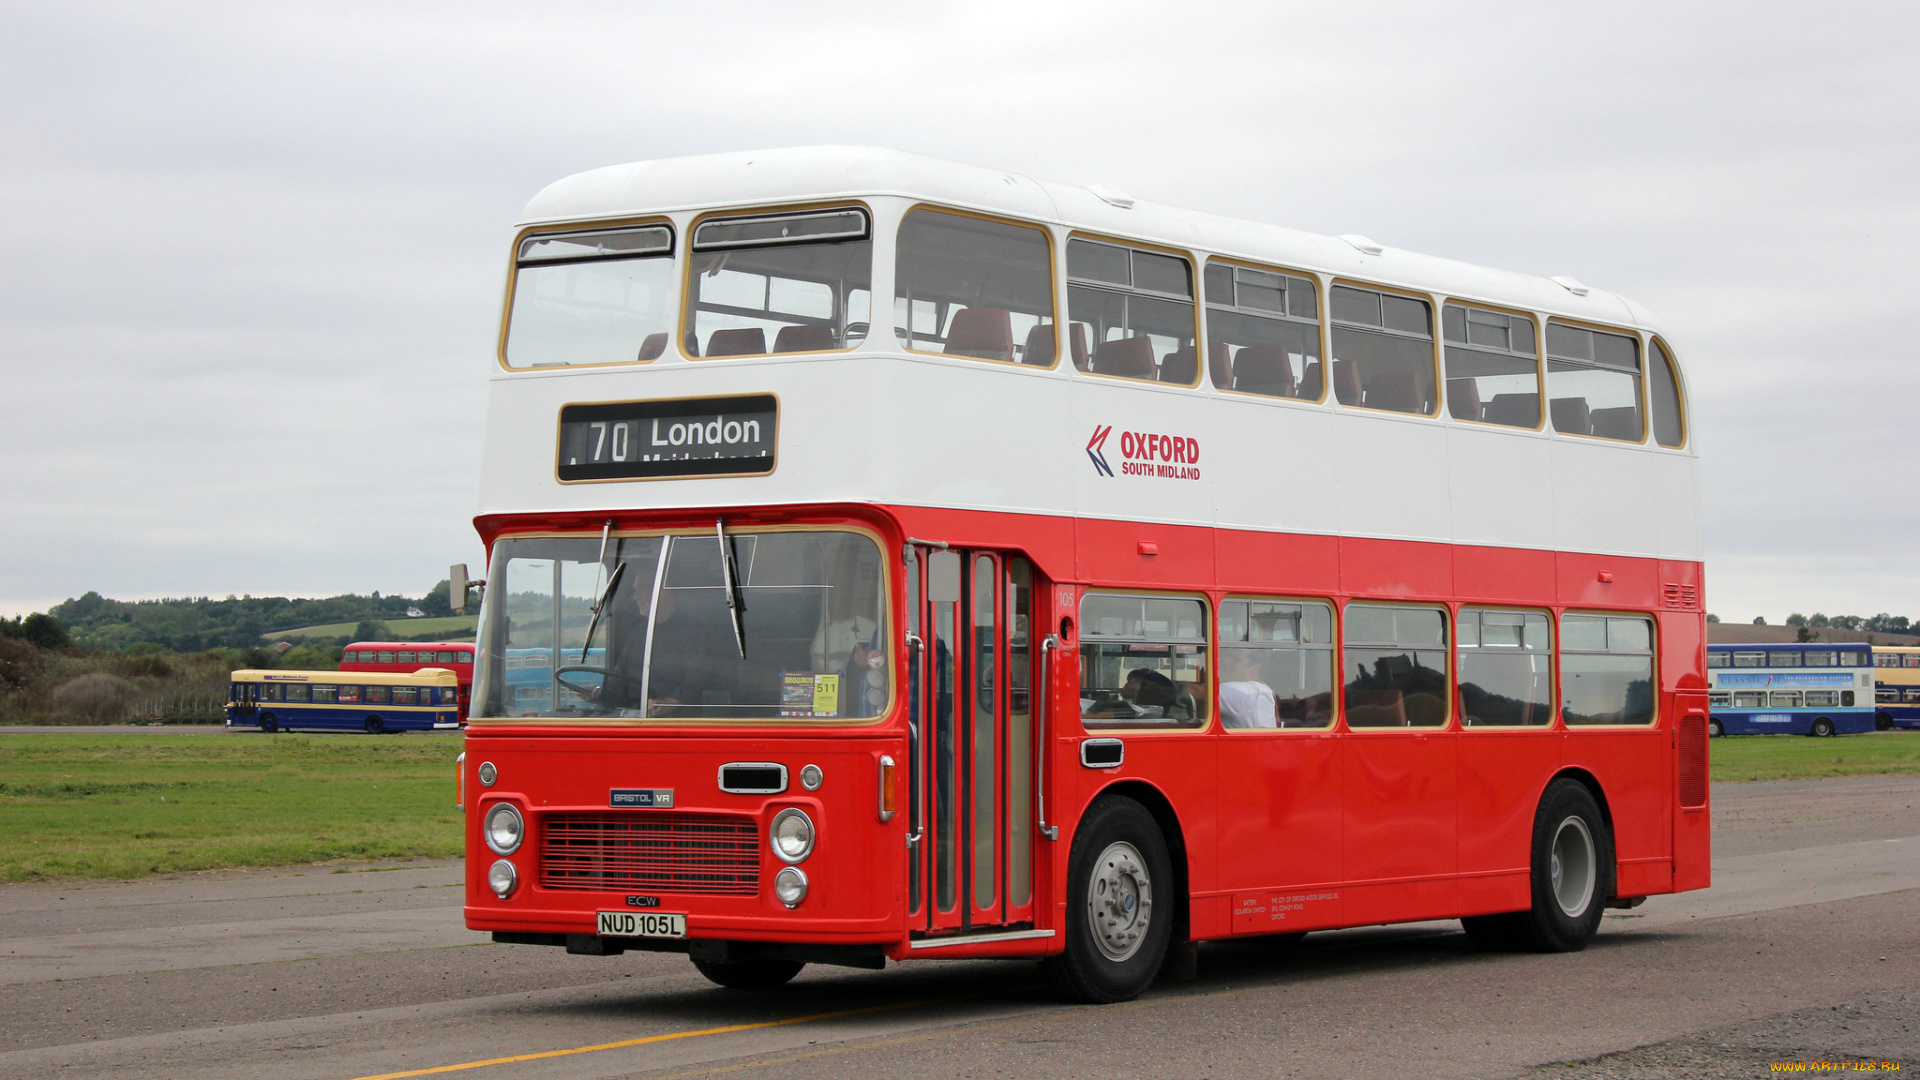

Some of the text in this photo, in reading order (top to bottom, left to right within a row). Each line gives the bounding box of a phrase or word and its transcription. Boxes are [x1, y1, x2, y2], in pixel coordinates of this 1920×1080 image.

[590, 415, 760, 462] 70 London
[1121, 431, 1199, 464] OXFORD
[1122, 462, 1200, 480] SOUTH MIDLAND
[1059, 592, 1074, 607] 105
[817, 683, 836, 693] 511
[613, 794, 670, 803] BRISTOL VR
[627, 896, 657, 906] ECW
[601, 914, 682, 936] NUD 105L
